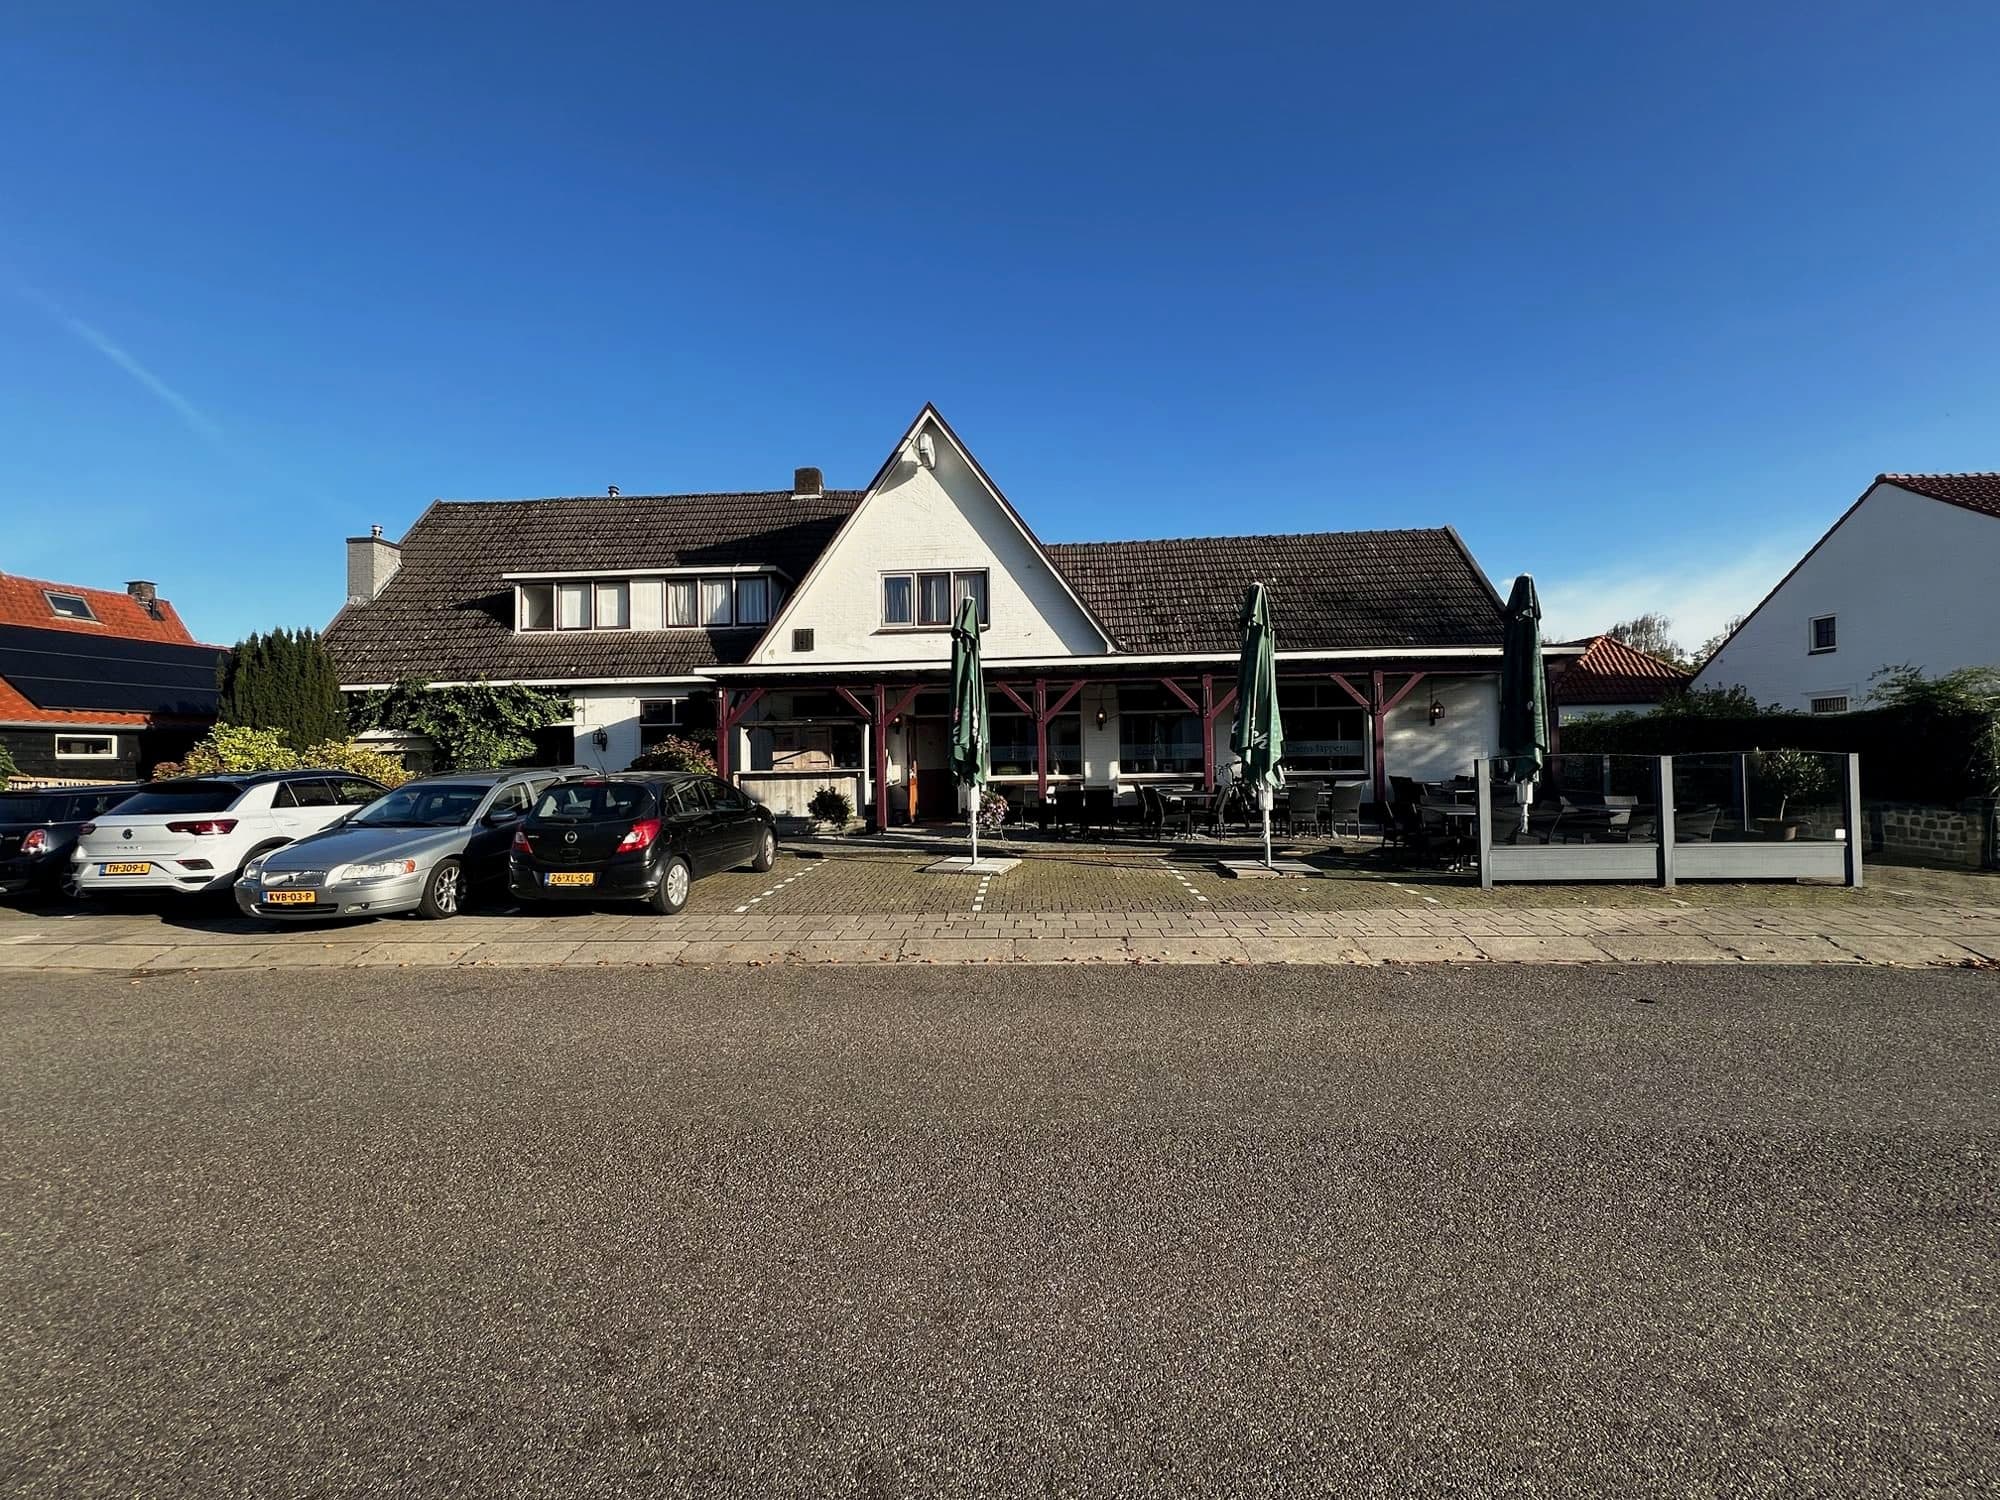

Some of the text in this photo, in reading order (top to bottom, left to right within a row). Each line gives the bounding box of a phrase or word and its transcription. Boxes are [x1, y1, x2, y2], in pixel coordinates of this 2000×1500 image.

[108, 864, 145, 873] TH-309-L
[551, 874, 590, 882] 26-XL-SG
[269, 893, 312, 902] KVB-03-P
